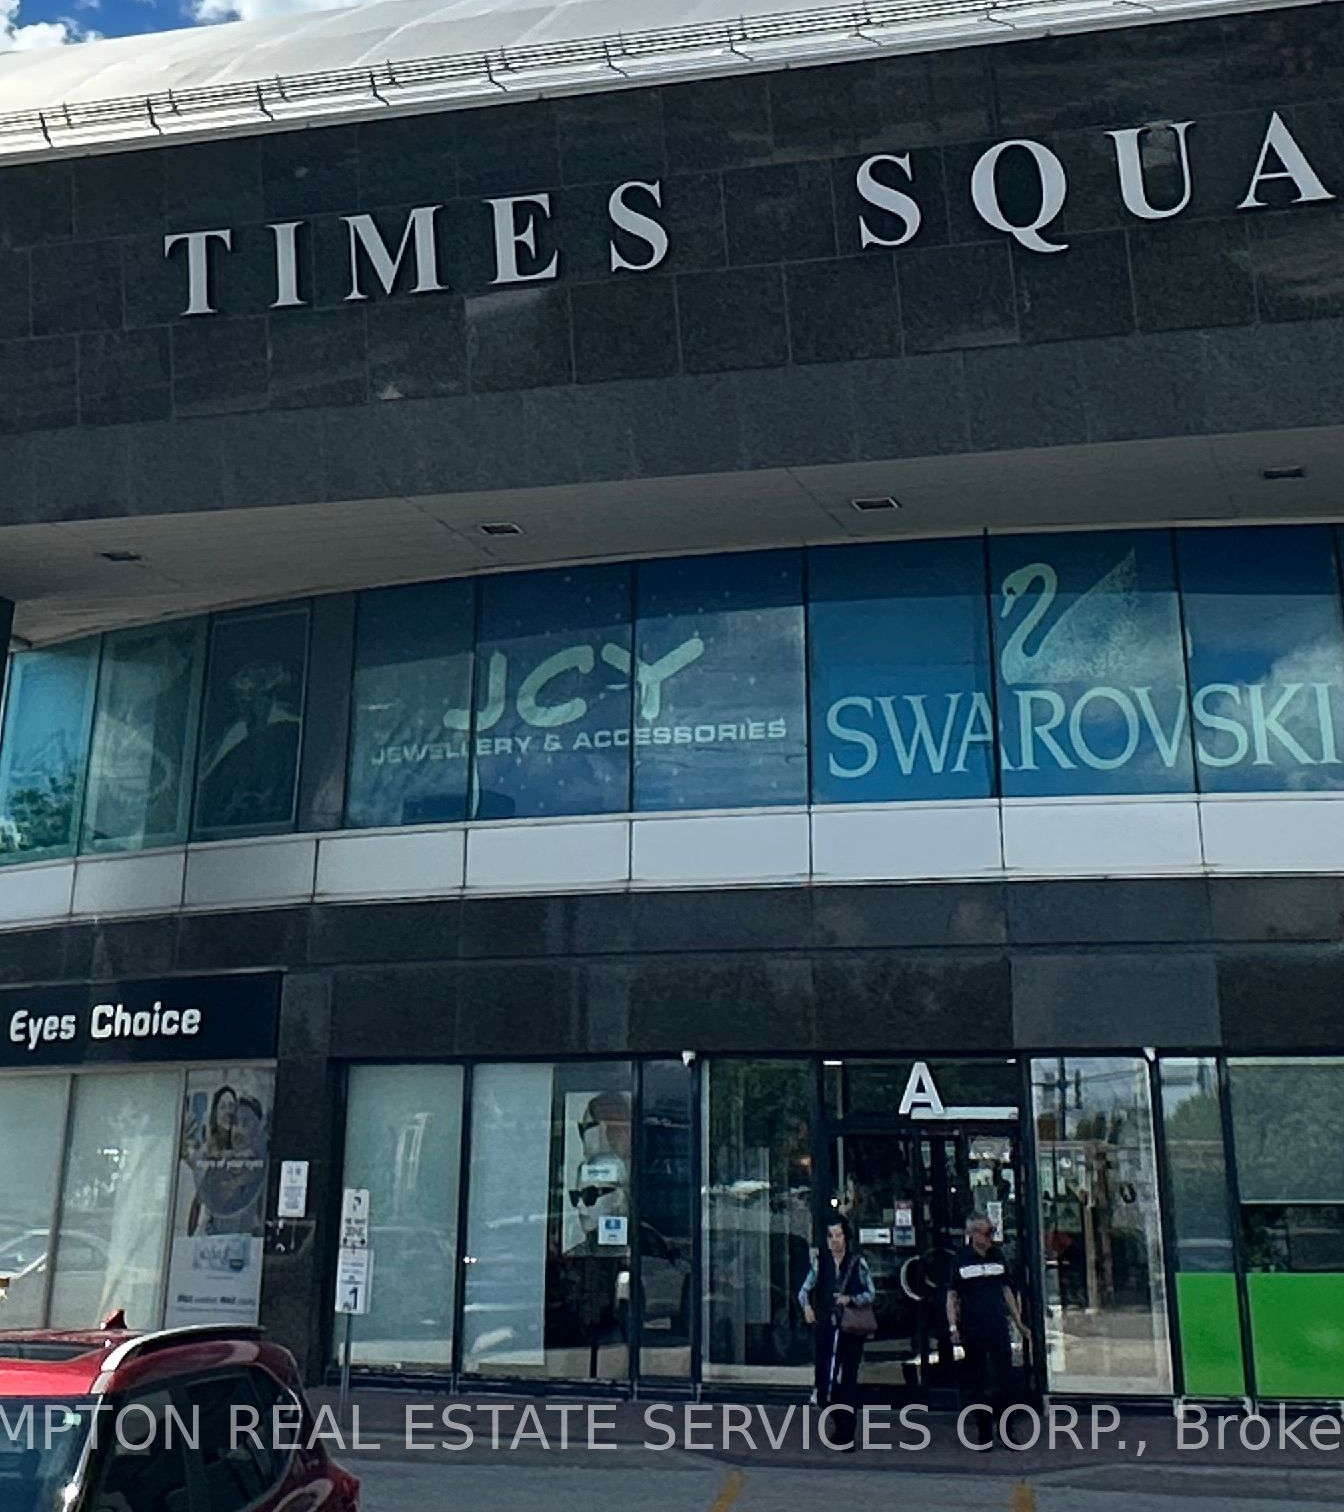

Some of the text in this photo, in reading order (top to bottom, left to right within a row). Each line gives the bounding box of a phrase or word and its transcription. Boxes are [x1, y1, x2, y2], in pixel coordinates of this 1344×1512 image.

[164, 180, 669, 316] TIMES
[443, 638, 704, 731] JCY
[371, 717, 787, 766] JEWELLERY & ACCESSORIES
[826, 681, 1344, 778] SWAROVSKI
[10, 1001, 202, 1050] Eyes Choice
[898, 1061, 944, 1115] A
